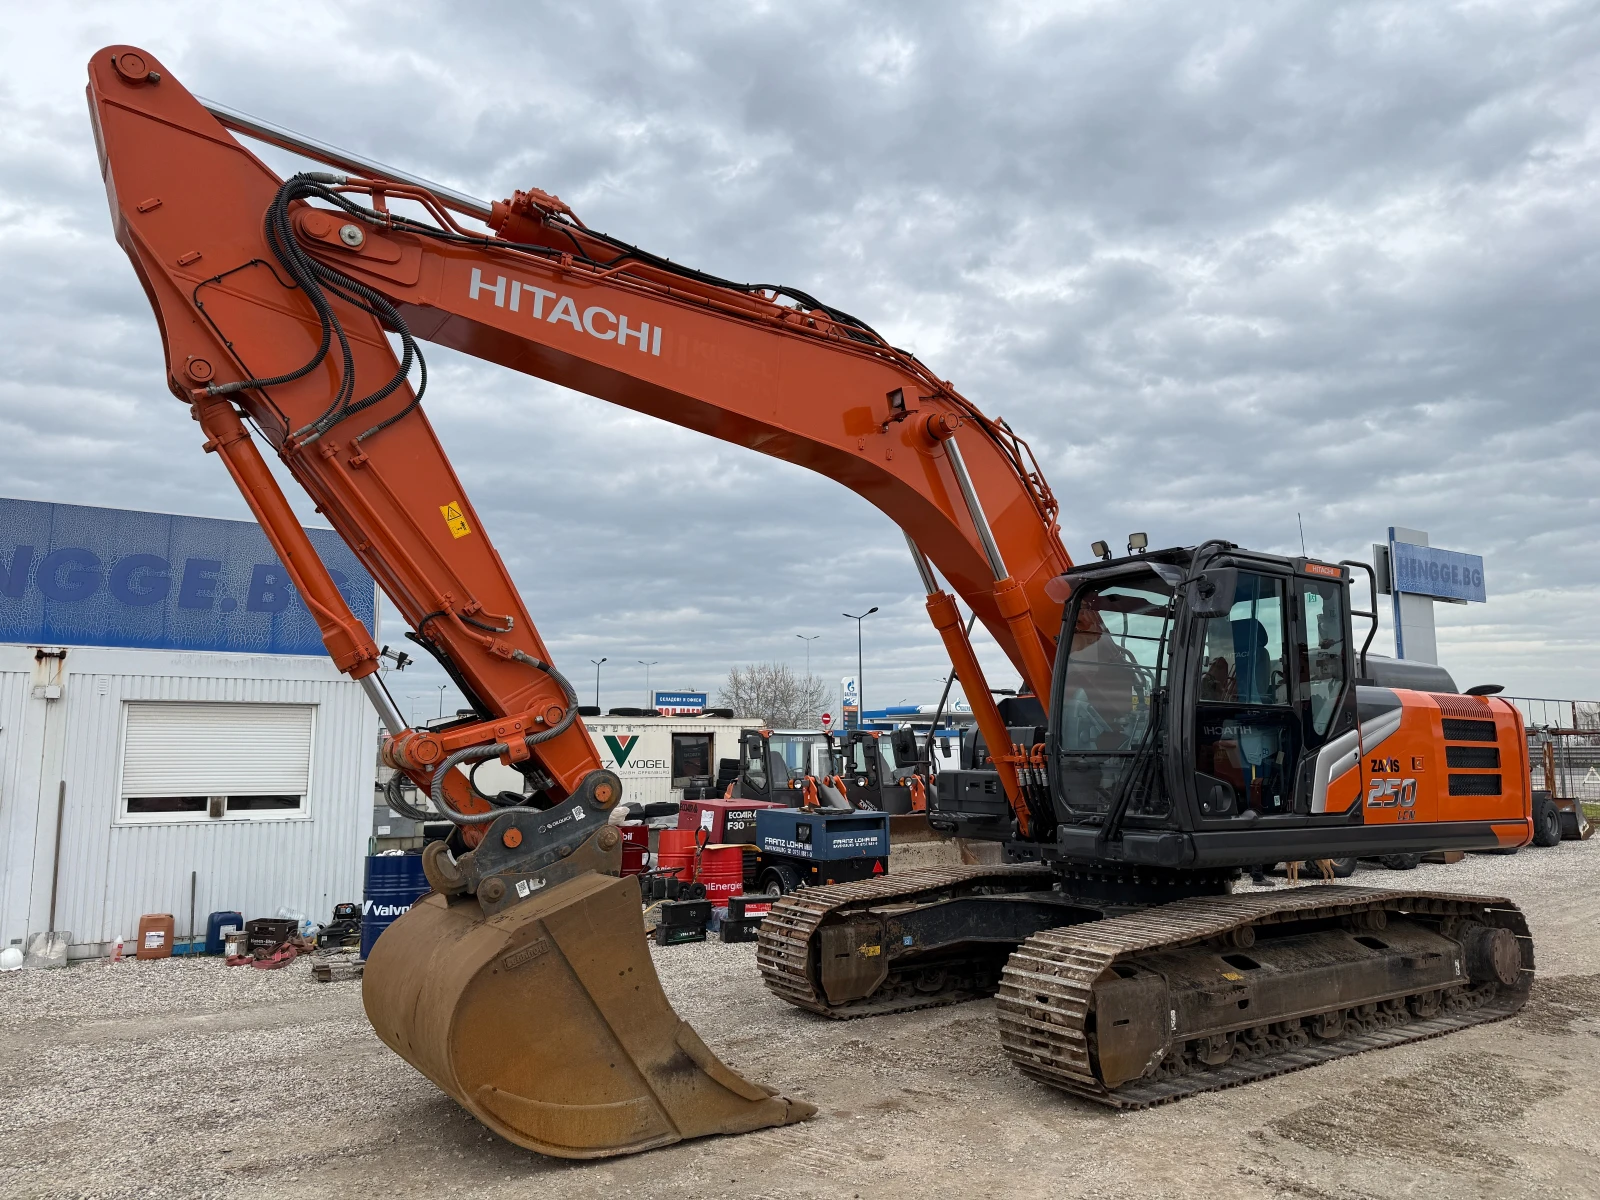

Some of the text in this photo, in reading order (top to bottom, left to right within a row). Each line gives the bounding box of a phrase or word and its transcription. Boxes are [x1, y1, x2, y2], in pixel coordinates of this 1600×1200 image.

[469, 267, 662, 357] HITACHI
[1312, 566, 1334, 576] HITACHI
[1400, 556, 1482, 588] HENGGE.BG
[628, 760, 670, 769] VOGEL
[1370, 756, 1400, 773] ZAXIS
[1367, 779, 1417, 808] 250
[728, 811, 752, 819] ECOAIR
[727, 821, 745, 831] F30
[622, 832, 633, 841] bil
[764, 837, 785, 847] FRANZ
[786, 840, 803, 850] LOHR
